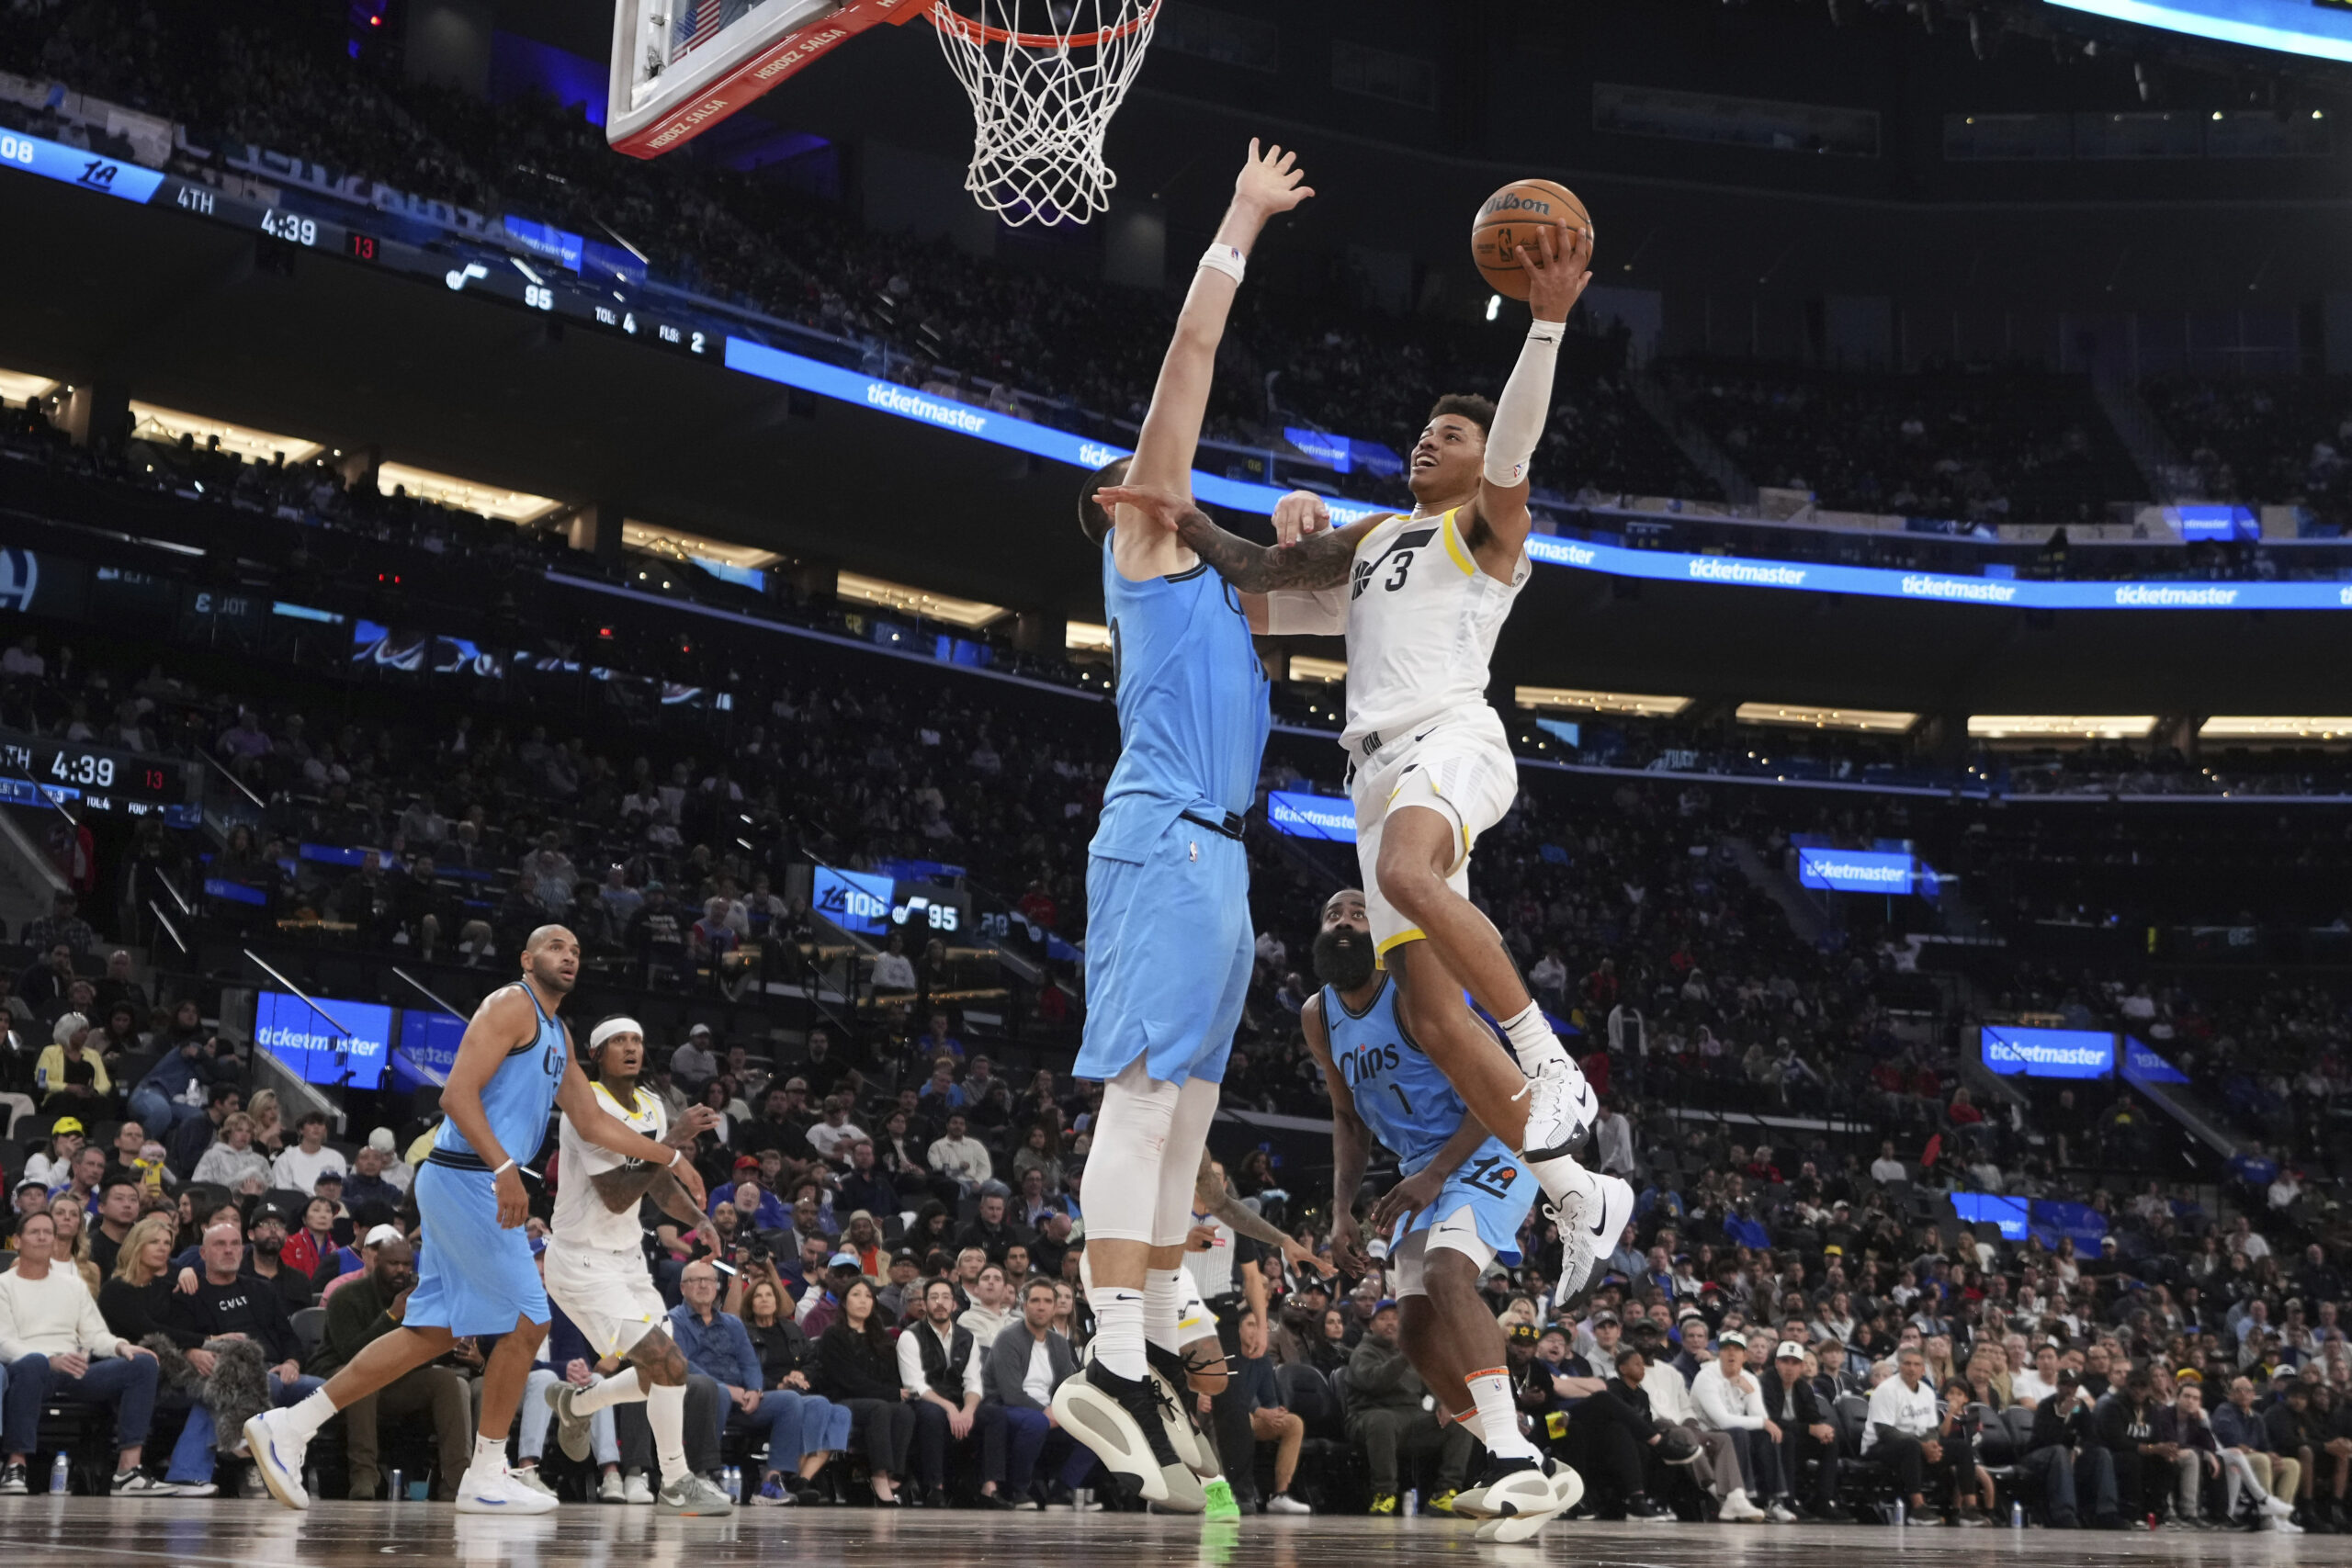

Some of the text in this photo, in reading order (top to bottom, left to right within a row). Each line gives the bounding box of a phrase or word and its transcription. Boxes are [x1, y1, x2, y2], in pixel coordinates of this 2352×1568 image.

[753, 28, 846, 80] HERDEZ SALSA
[647, 98, 728, 150] HERDEZ SALSA
[0, 137, 34, 164] 08
[176, 186, 373, 259] 4TH 4:39 13
[525, 285, 552, 310] 95
[595, 306, 637, 334] TOL: 4
[691, 332, 705, 354] 2
[866, 383, 987, 434] ticketmaster
[1523, 538, 1595, 565] tmaster
[1385, 550, 1414, 592] 3
[1689, 558, 1806, 585] ticketmaster
[1902, 575, 2016, 602] ticketmaster
[2115, 584, 2238, 606] ticketmaster
[0, 744, 163, 789] TH 4:39 13
[1273, 805, 1357, 829] ticketmaste
[1805, 863, 1905, 883] ticketmaster
[928, 905, 958, 931] 95
[258, 1027, 379, 1056] ticketmaster
[1989, 1042, 2106, 1066] ticketmaster
[1340, 1043, 1400, 1089] Clips
[1388, 1084, 1413, 1115] 1
